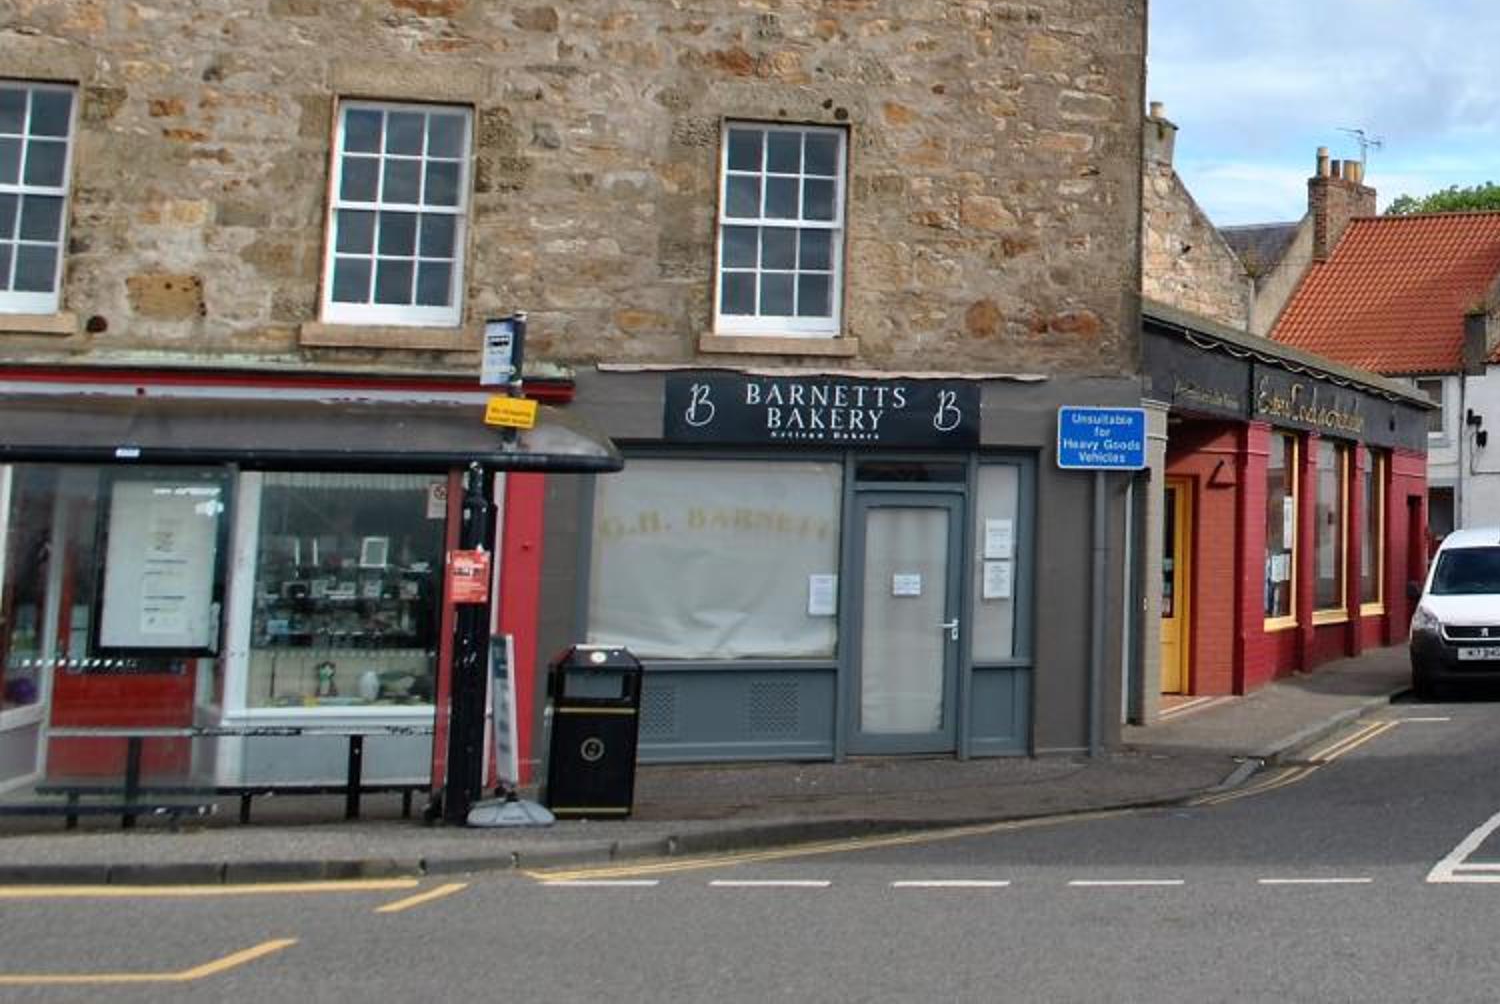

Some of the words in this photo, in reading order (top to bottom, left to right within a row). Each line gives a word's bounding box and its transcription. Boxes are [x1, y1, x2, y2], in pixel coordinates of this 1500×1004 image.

[745, 382, 907, 409] BARNETTS
[766, 407, 884, 431] BAKERY
[1071, 413, 1134, 425] Unsuitable
[1094, 426, 1112, 437] for
[1063, 438, 1099, 451] Heavy
[1103, 439, 1141, 451] Goods
[1079, 452, 1127, 463] Vehicles
